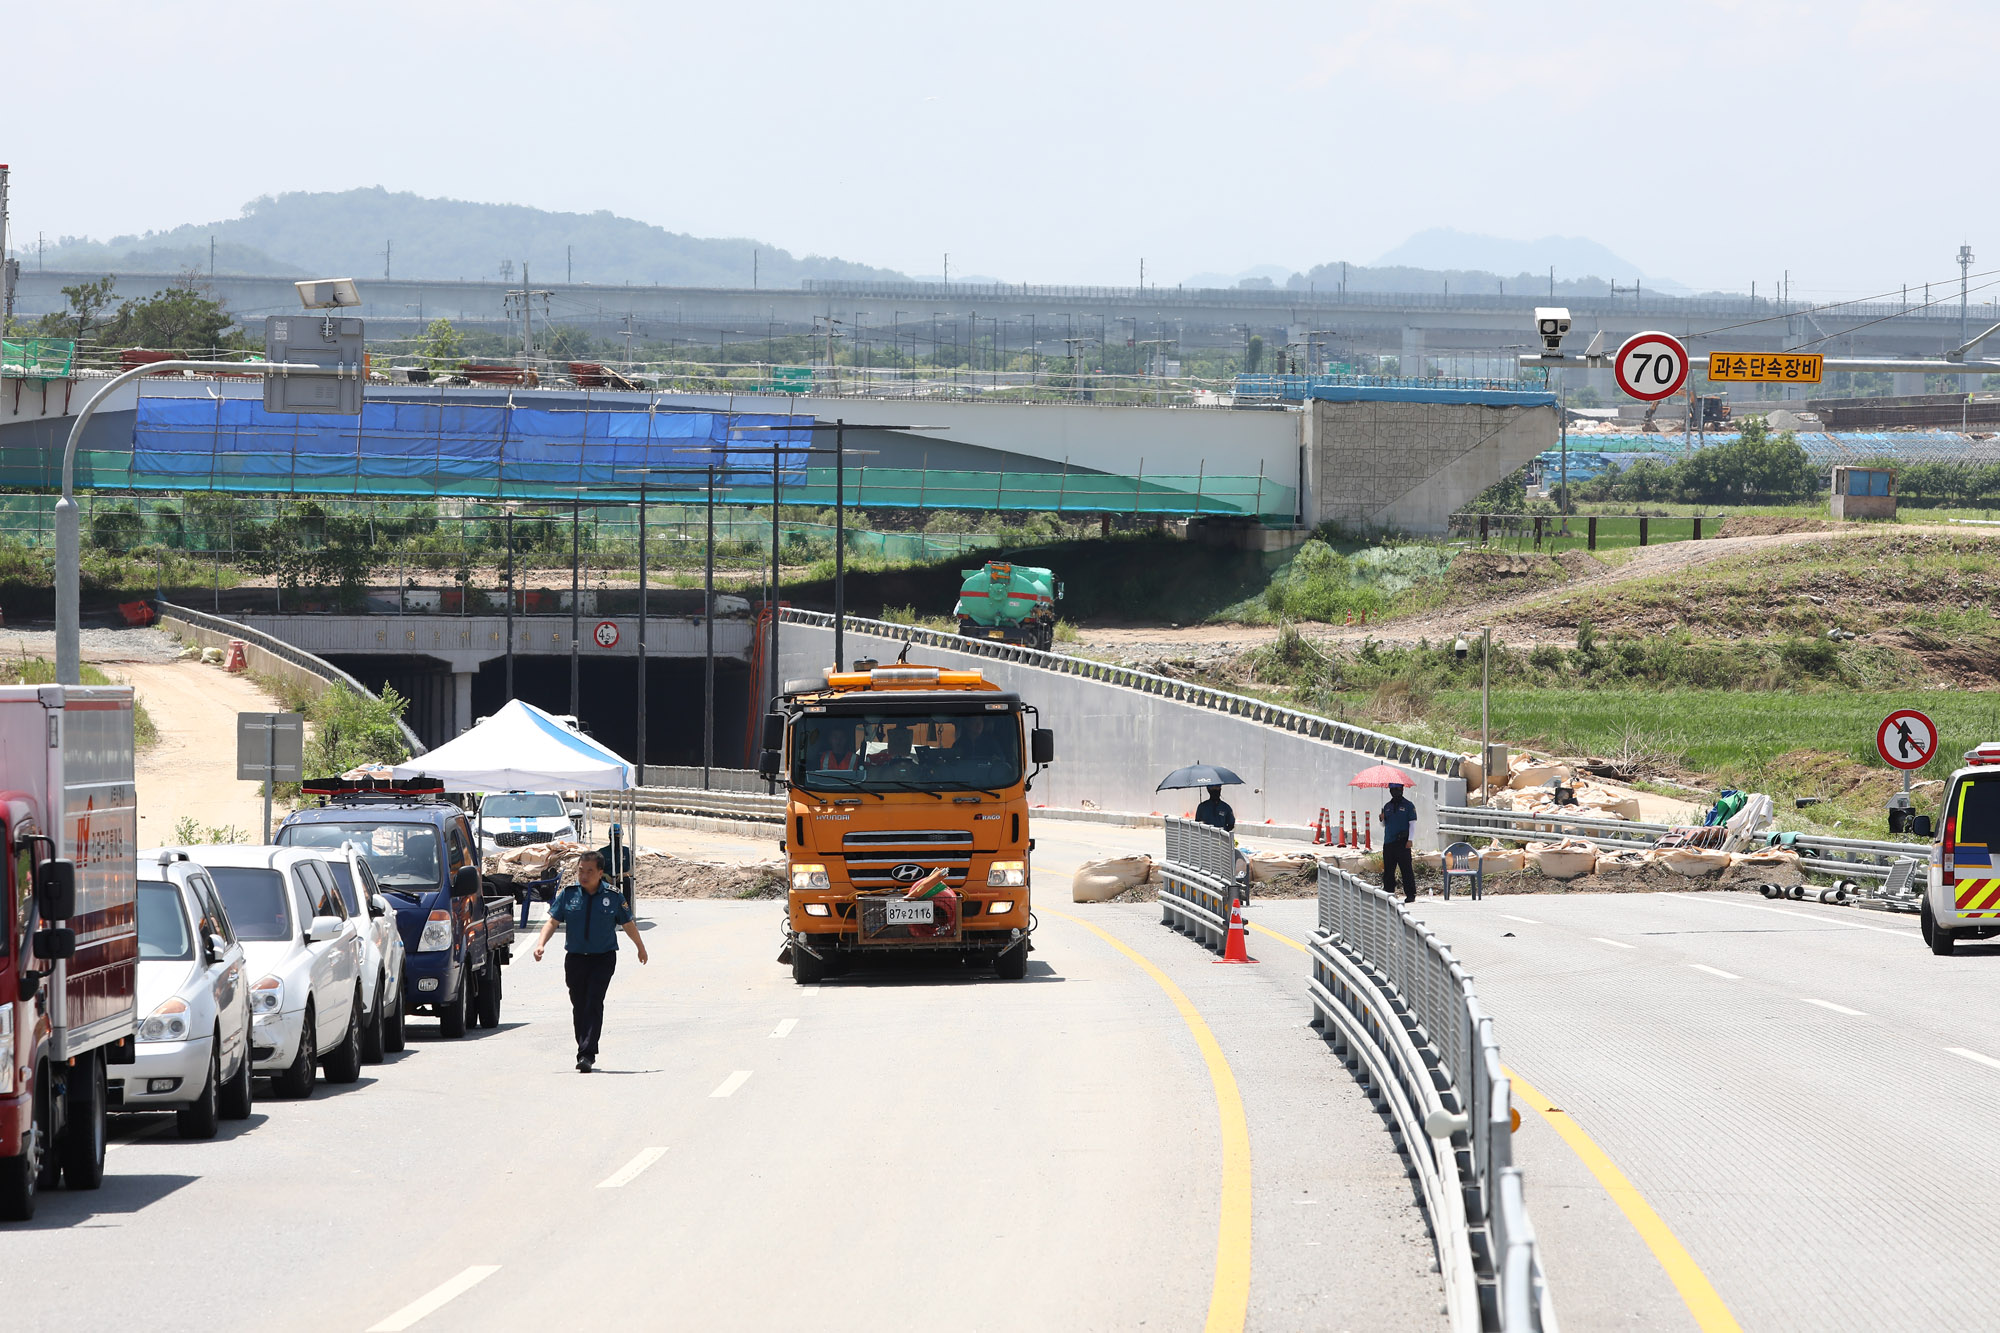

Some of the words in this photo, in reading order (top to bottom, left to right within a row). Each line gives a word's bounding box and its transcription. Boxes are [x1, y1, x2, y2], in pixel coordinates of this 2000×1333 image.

[1632, 353, 1674, 385] 70
[1714, 357, 1817, 379] 과속단속장비
[889, 908, 932, 920] 87우2116
